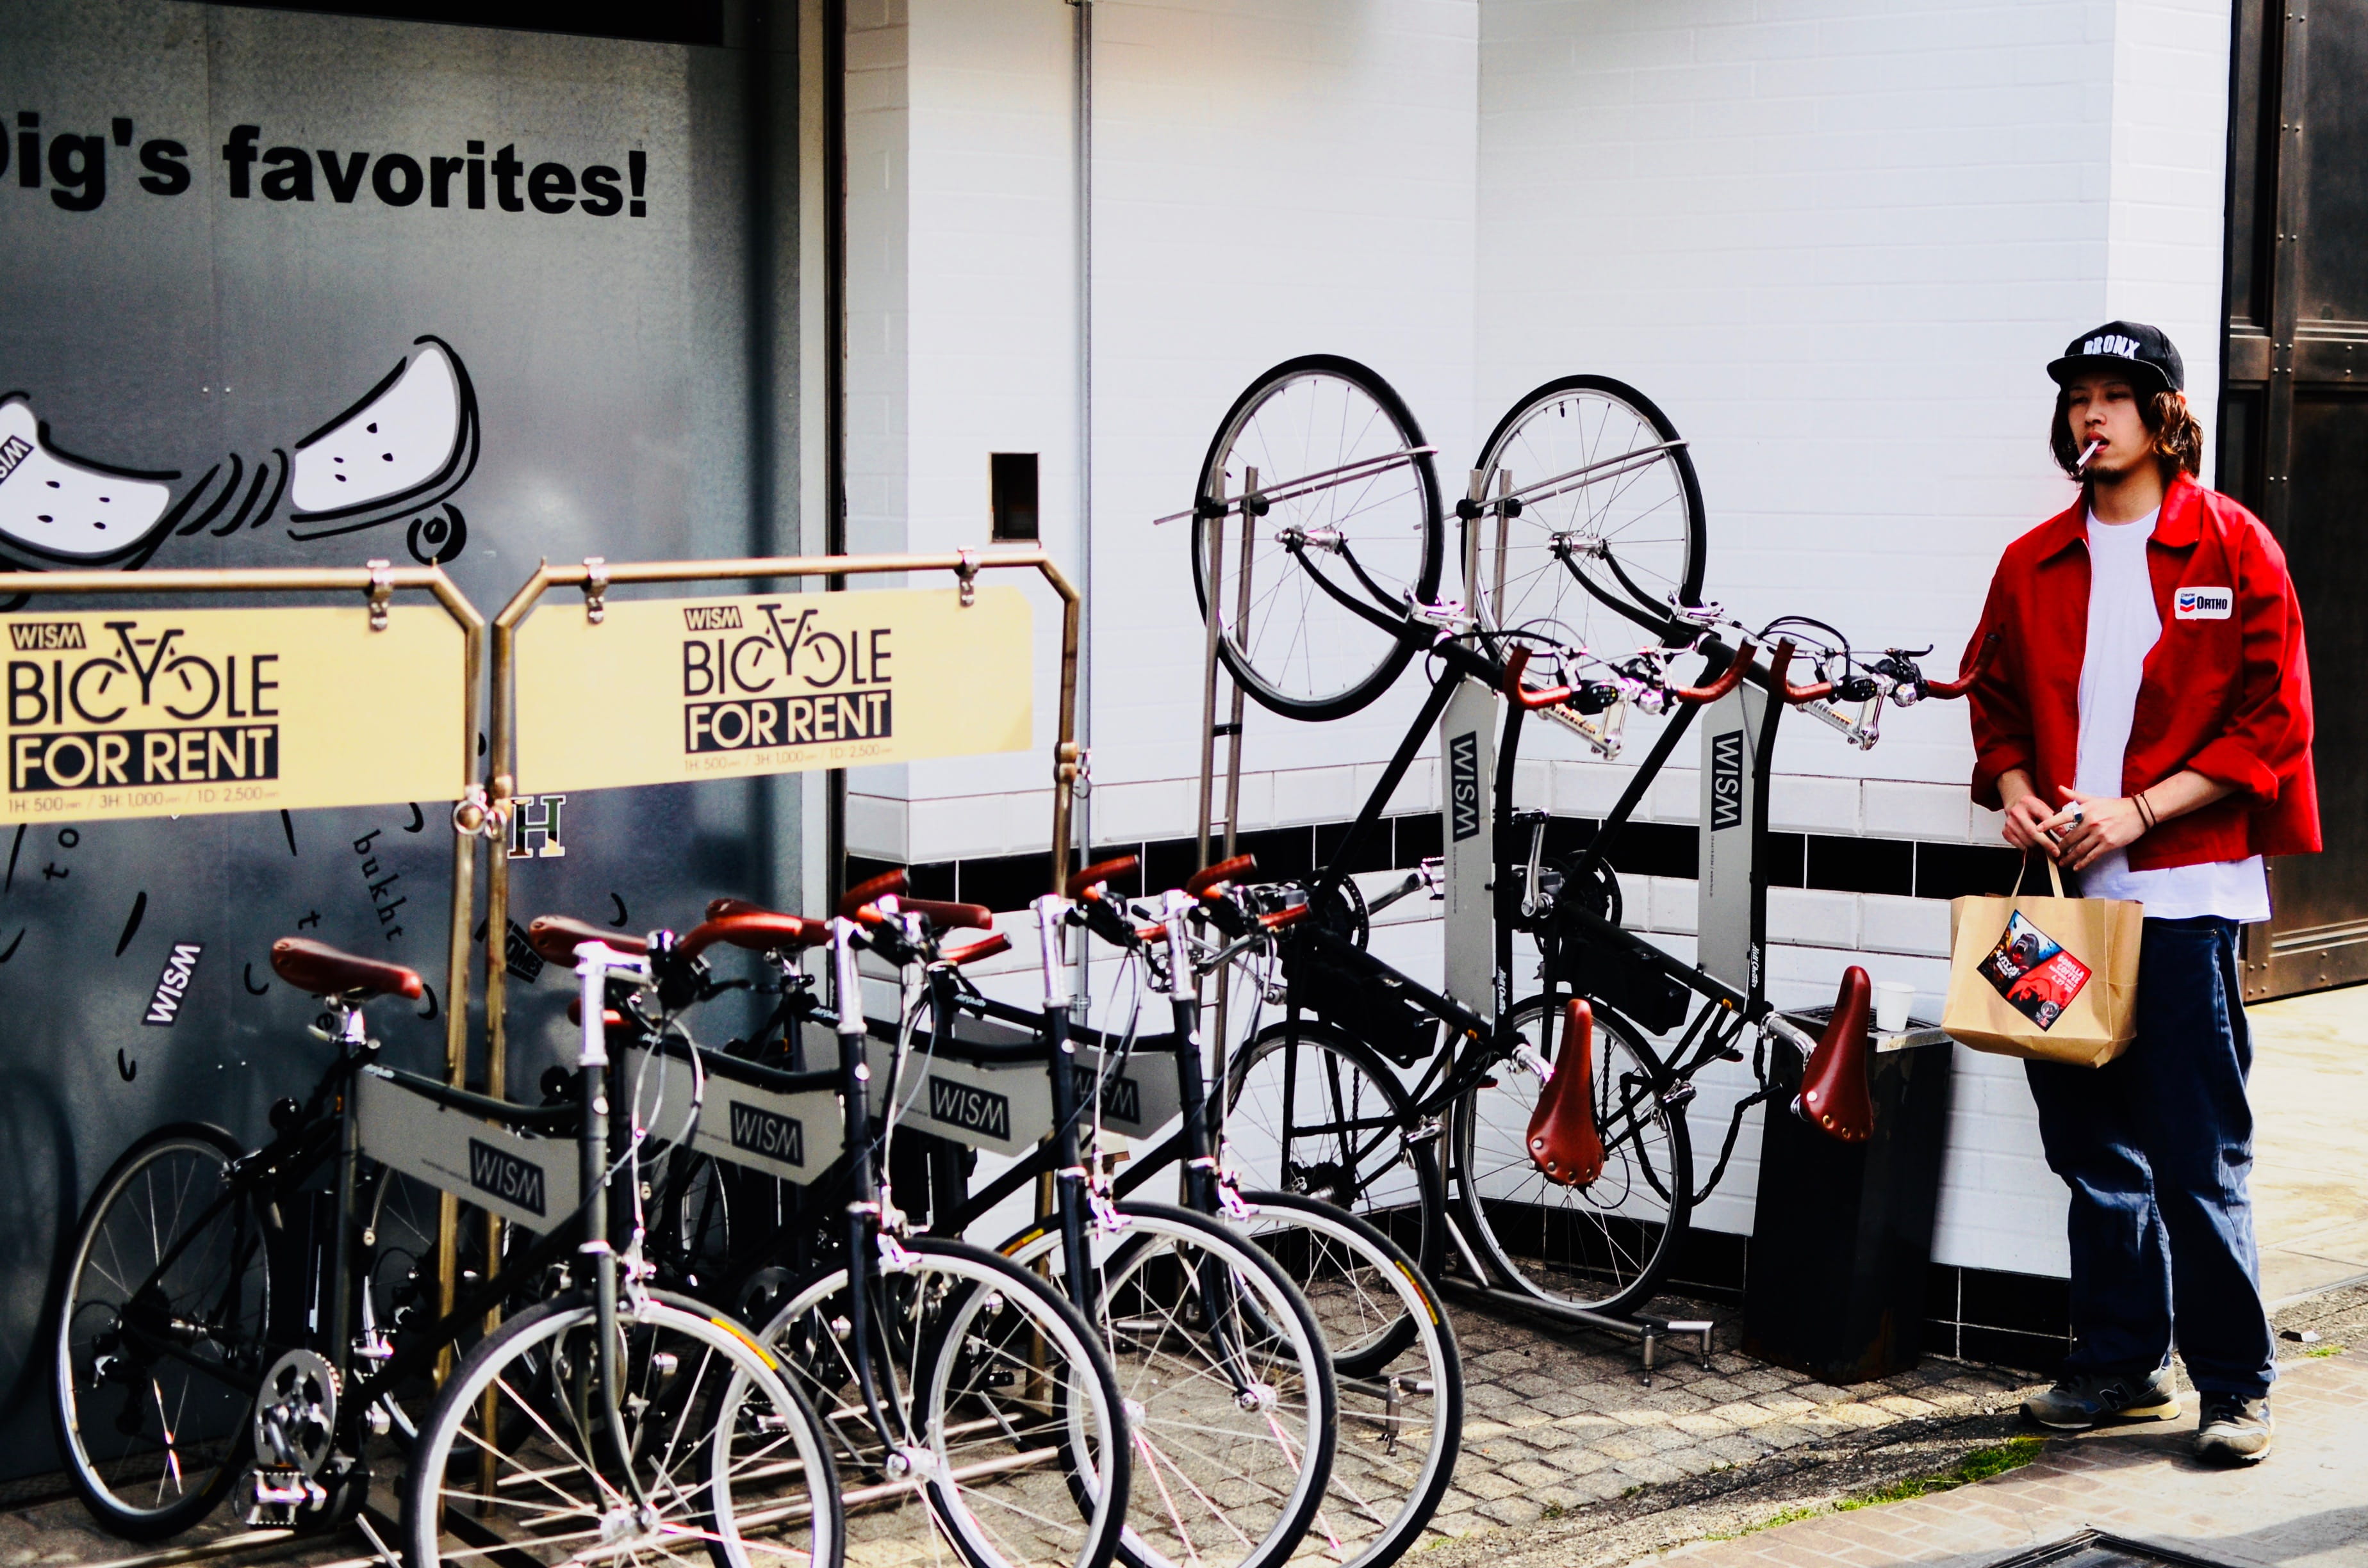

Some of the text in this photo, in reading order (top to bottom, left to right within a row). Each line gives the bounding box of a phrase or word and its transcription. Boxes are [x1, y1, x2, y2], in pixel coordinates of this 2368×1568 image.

[0, 112, 646, 217] ig's favorites!
[2083, 334, 2140, 360] BRONX
[686, 607, 741, 629] WISM
[2197, 596, 2228, 610] ORTHO
[12, 624, 83, 649] WISM
[684, 603, 891, 697] BICYCLE
[8, 621, 278, 726] BICYCLE
[689, 693, 887, 750] FOR RENT
[15, 728, 272, 788] FOR RENT
[1715, 737, 1739, 826] WISM
[1454, 739, 1476, 835] WISM
[147, 945, 201, 1022] WISM
[2057, 955, 2084, 978] GORILLA
[2057, 964, 2081, 984] COFFEE
[735, 1108, 799, 1160] WISM
[935, 1082, 1004, 1134] WISM
[474, 1146, 540, 1208] WISM
[2099, 1383, 2133, 1411] N
